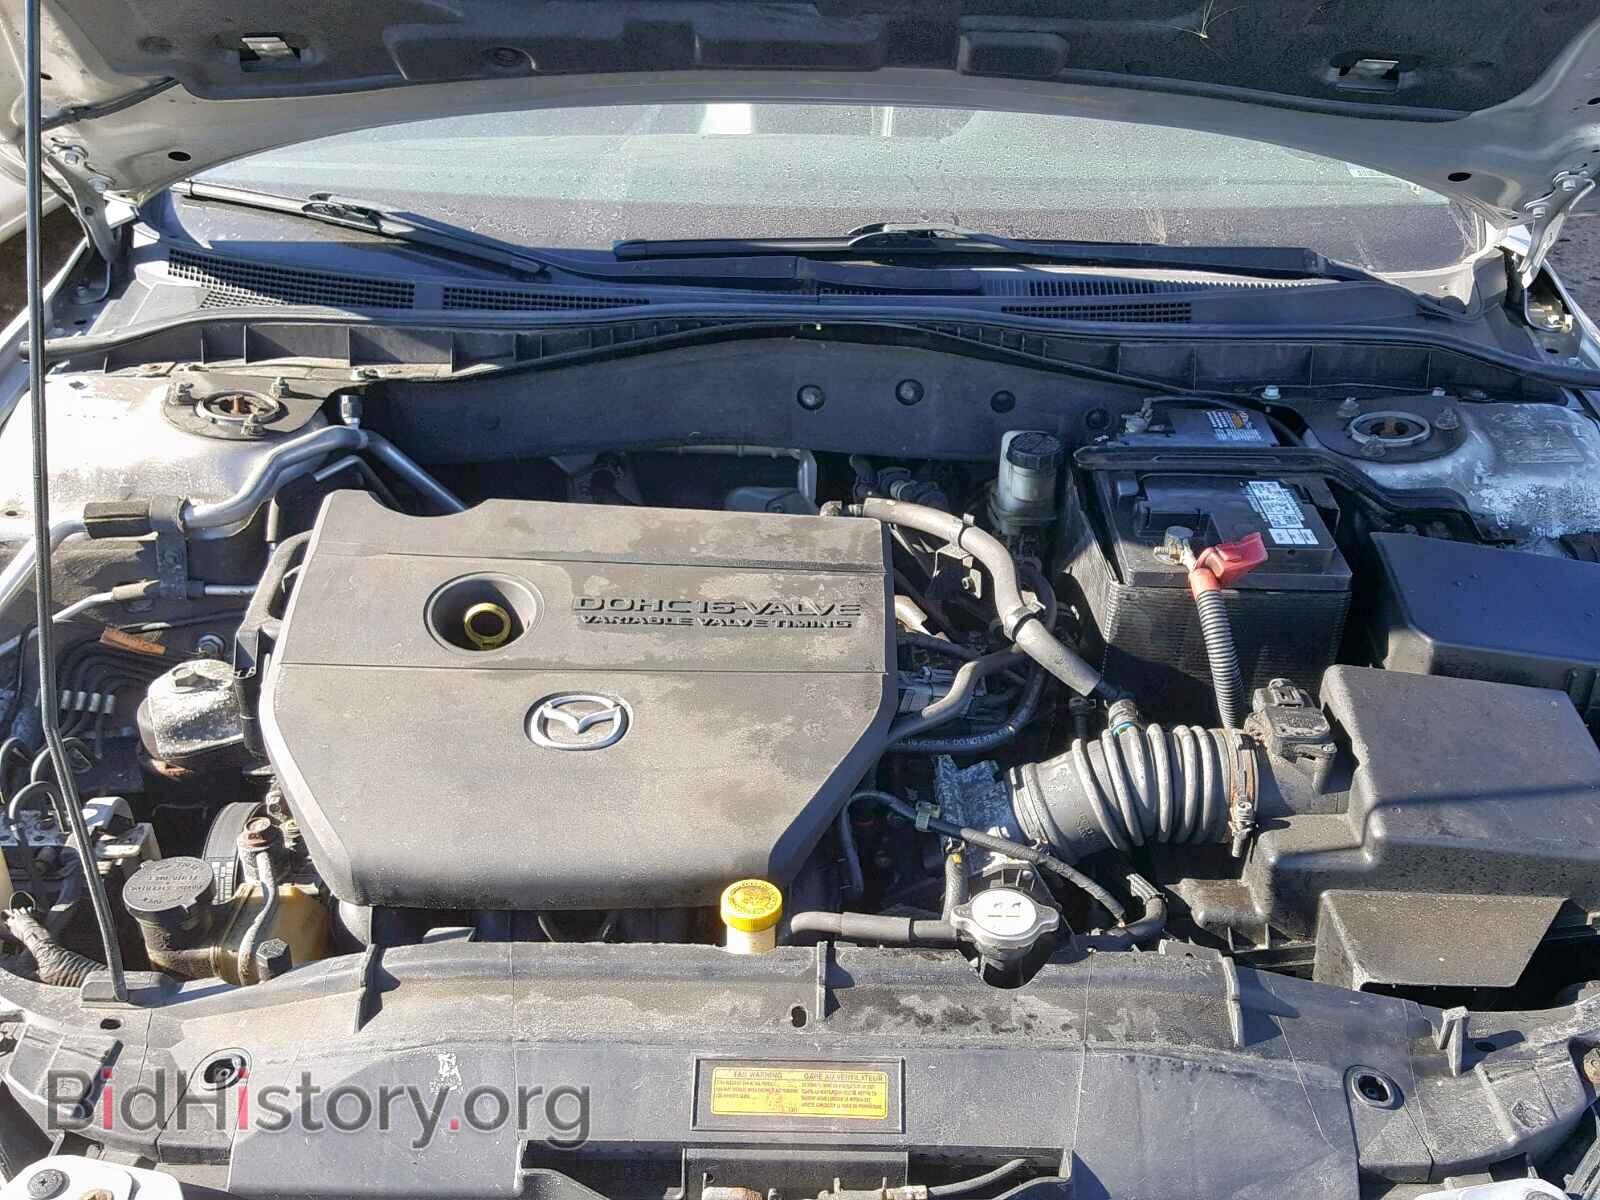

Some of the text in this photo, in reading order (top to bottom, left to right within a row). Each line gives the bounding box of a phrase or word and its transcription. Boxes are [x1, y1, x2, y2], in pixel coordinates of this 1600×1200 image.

[574, 598, 692, 613] DOHC
[578, 614, 853, 629] VARIABLE VALVE TIMING
[750, 1071, 783, 1079] WARNING
